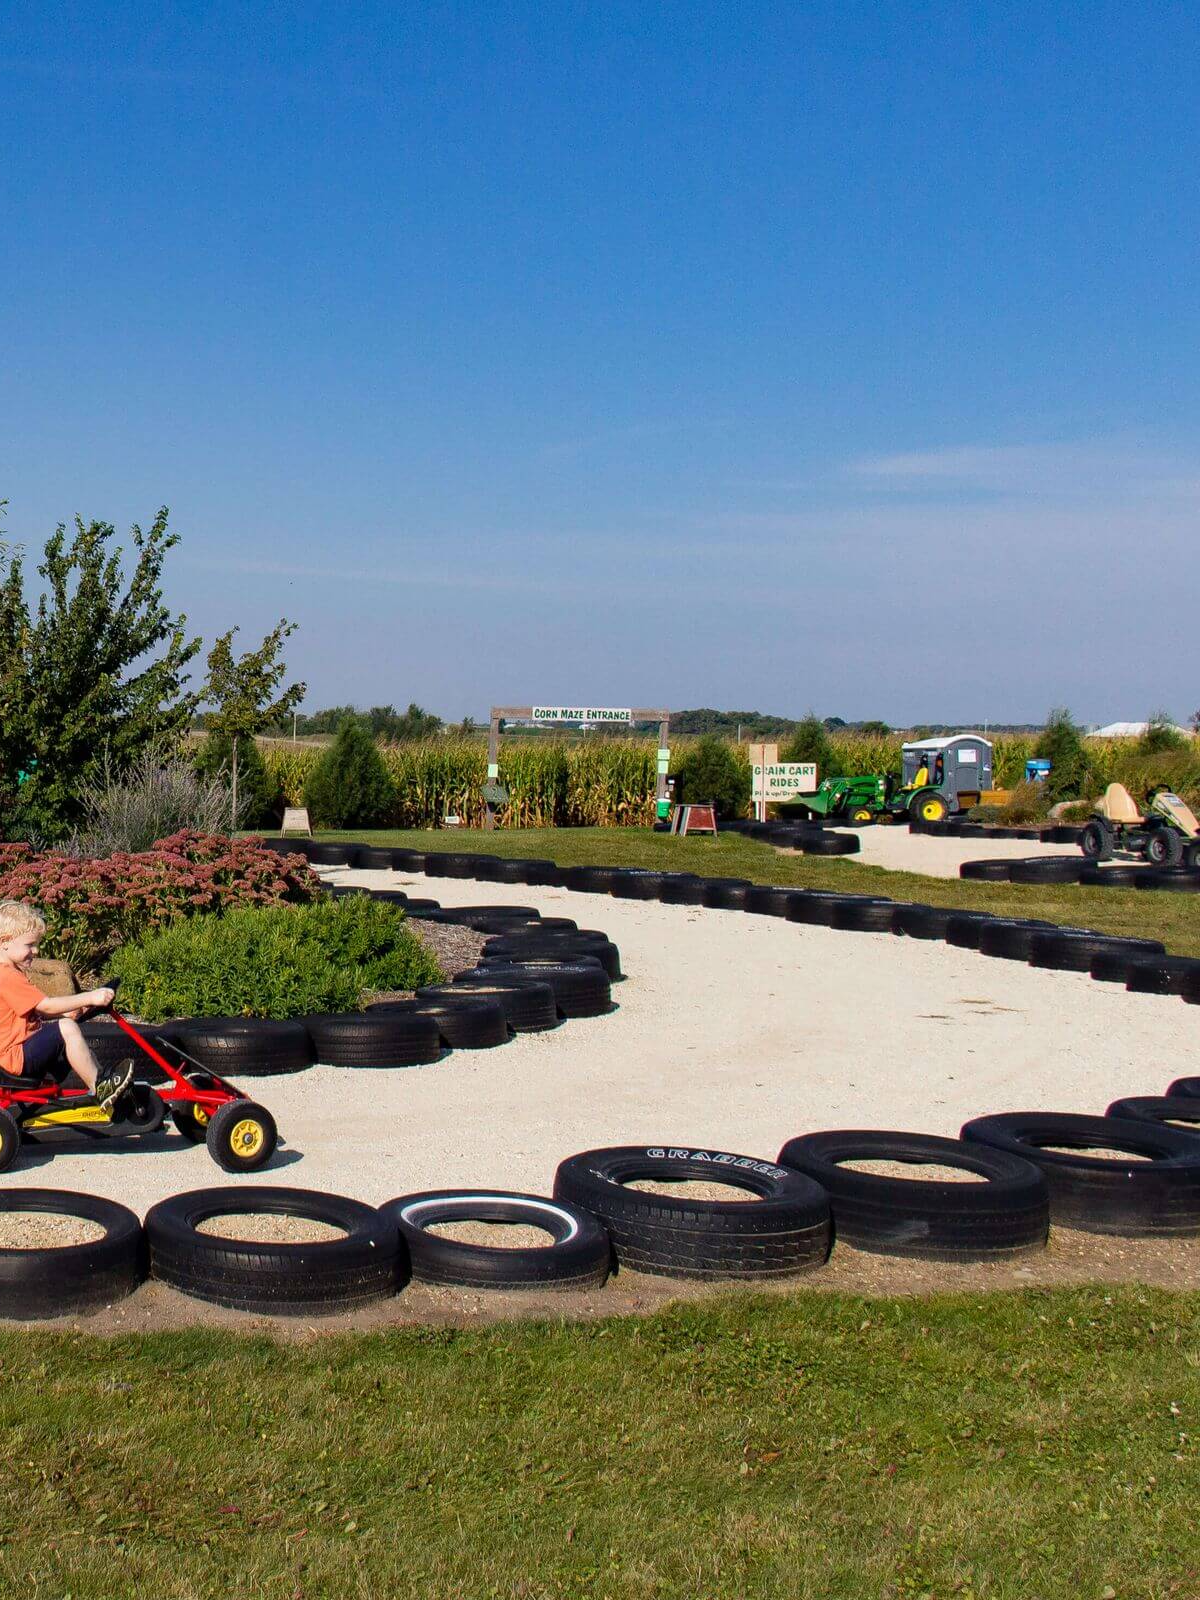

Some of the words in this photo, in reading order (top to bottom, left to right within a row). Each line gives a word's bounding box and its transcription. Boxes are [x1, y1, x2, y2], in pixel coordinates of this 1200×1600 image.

[534, 708, 558, 719] CORN
[560, 709, 584, 719] MAZE
[586, 709, 630, 720] ENTRANCE
[788, 766, 815, 775] CART
[770, 778, 799, 787] RIDES
[646, 1148, 788, 1179] GRABBER
